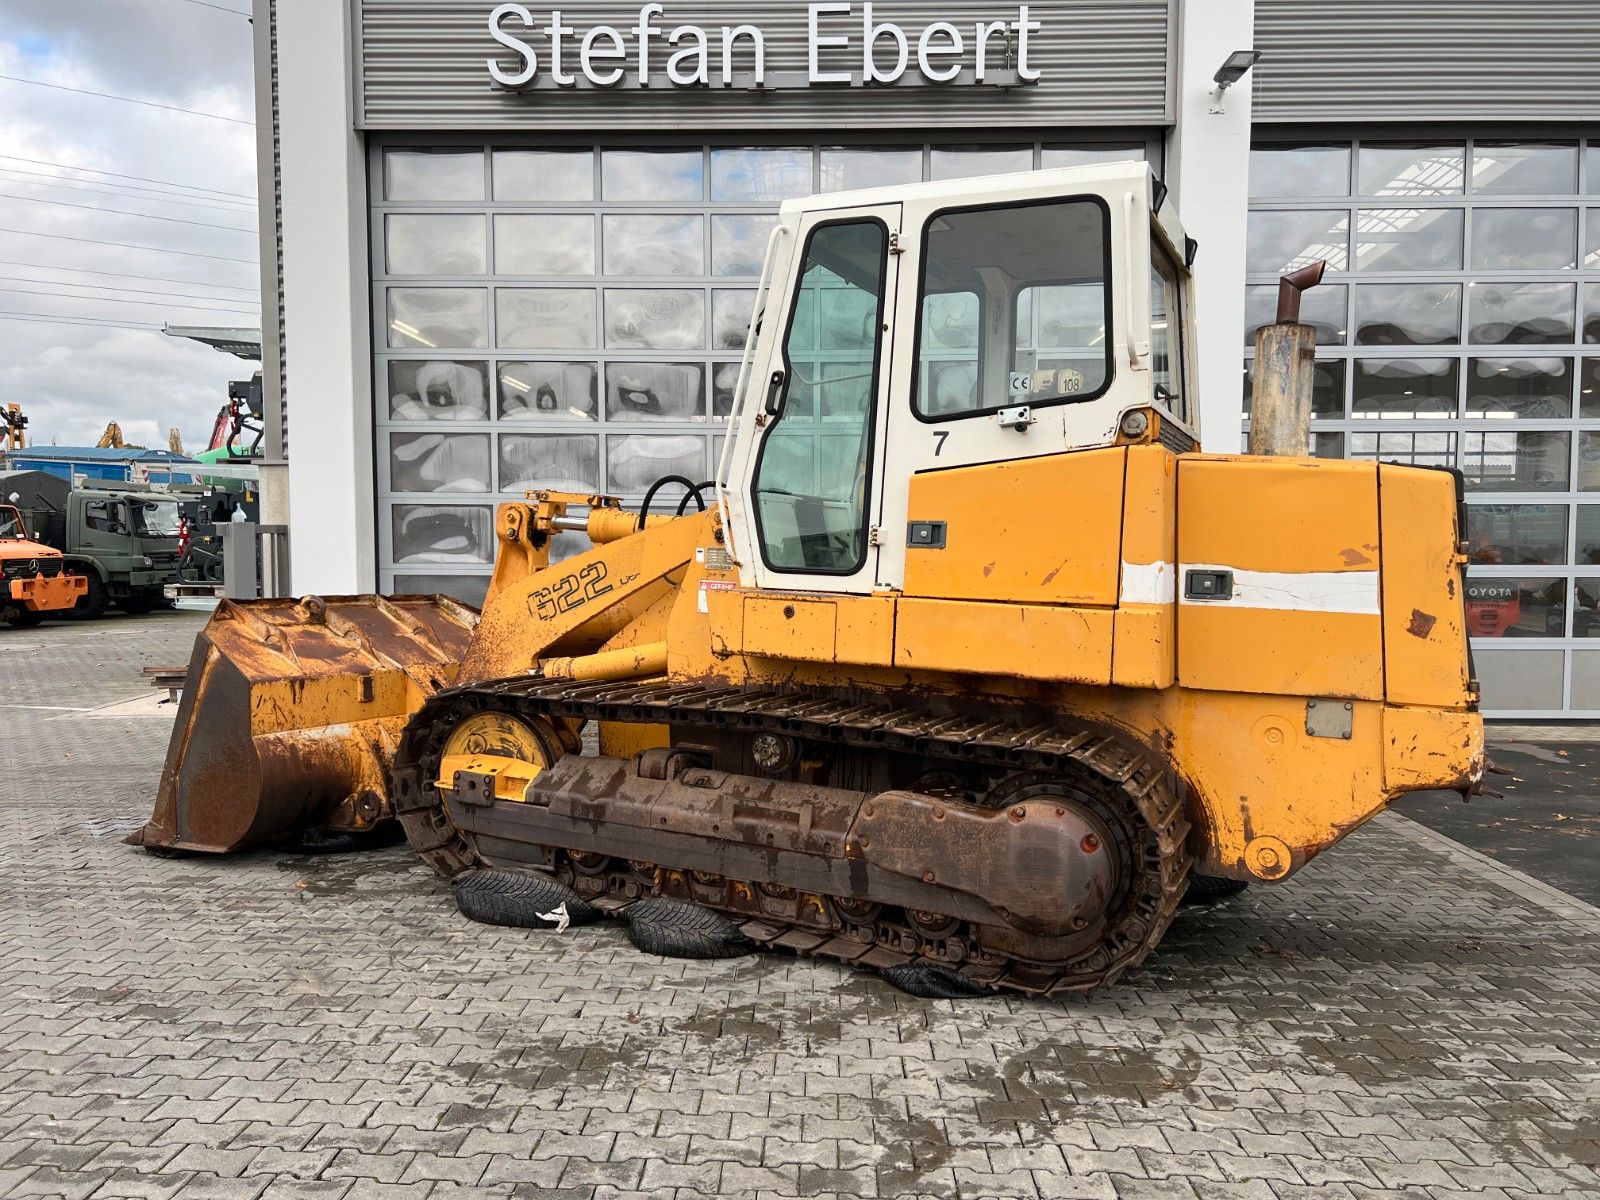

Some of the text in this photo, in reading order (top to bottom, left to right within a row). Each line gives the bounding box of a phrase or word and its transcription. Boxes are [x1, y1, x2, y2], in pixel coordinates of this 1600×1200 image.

[487, 1, 1042, 87] Stefan Ebert
[1012, 377, 1028, 390] CE
[1063, 378, 1080, 393] 108
[933, 431, 949, 456] 7
[1465, 587, 1512, 596] OYOTA
